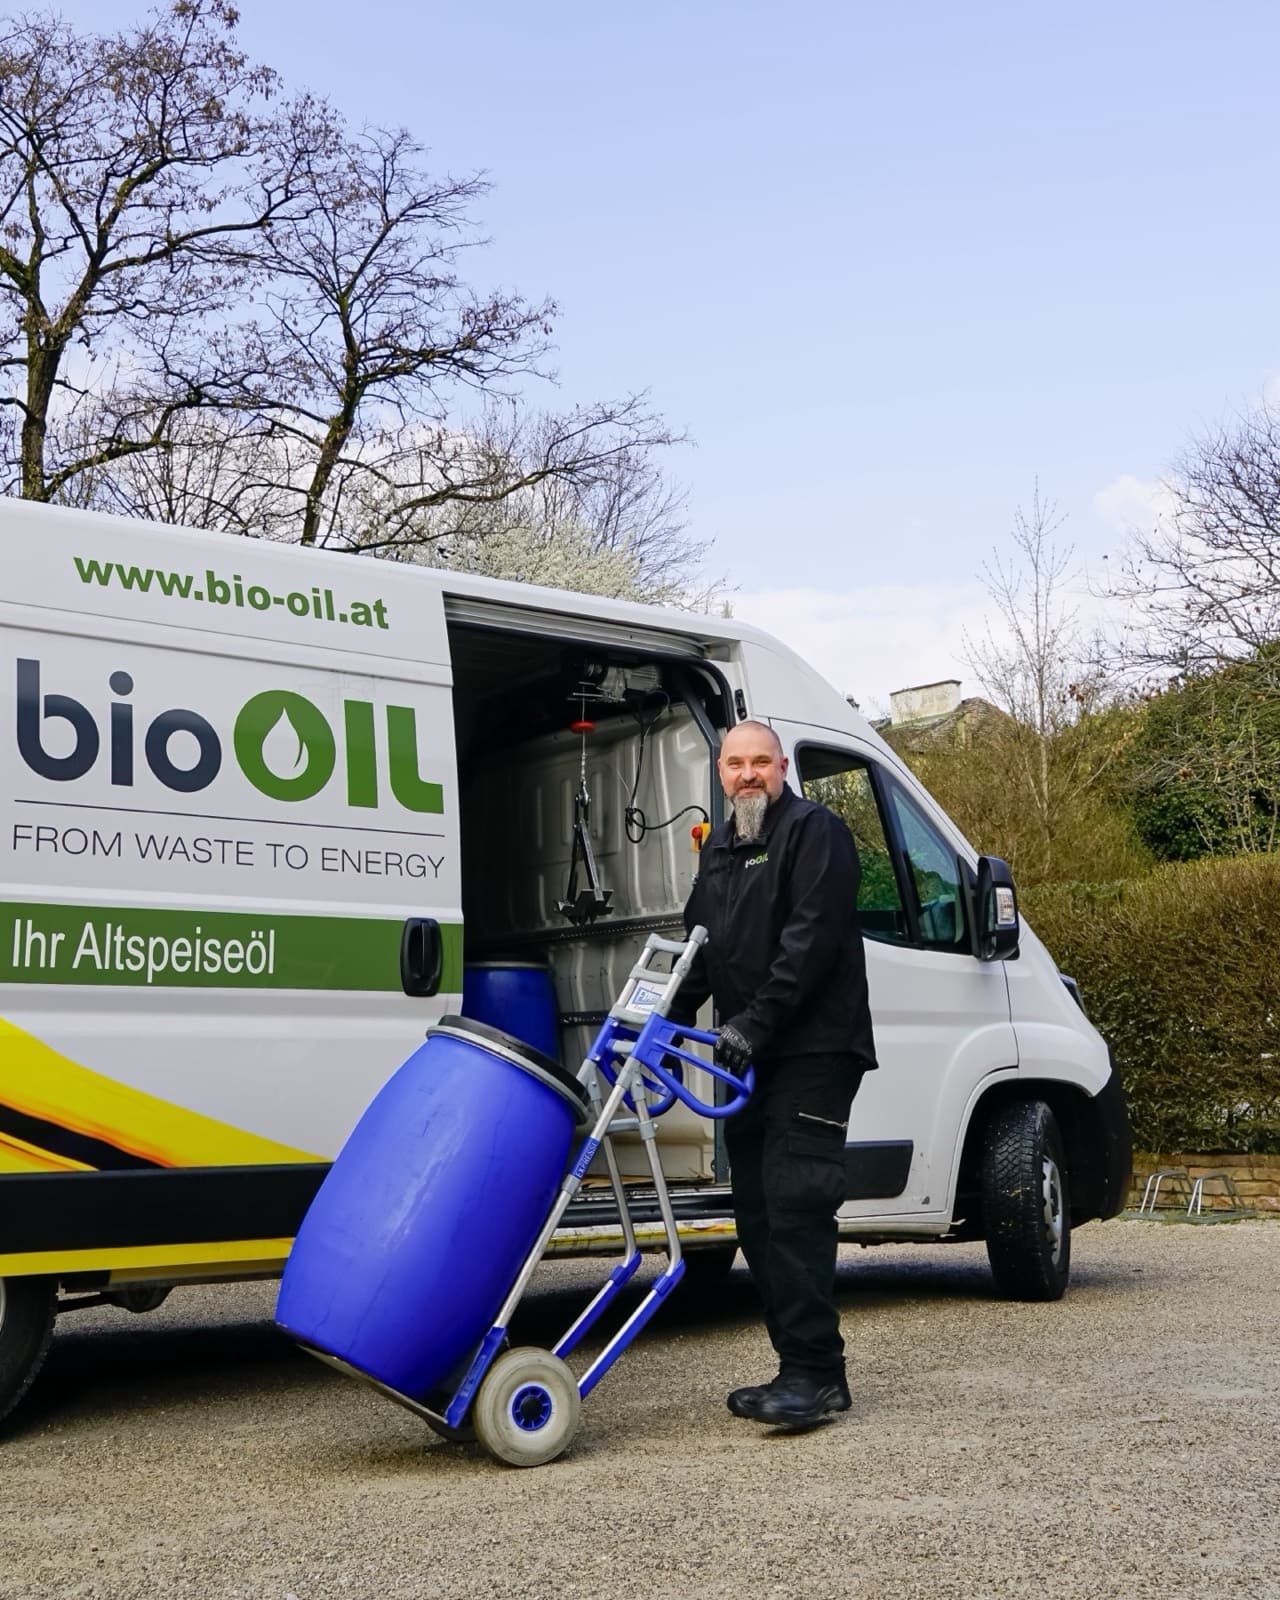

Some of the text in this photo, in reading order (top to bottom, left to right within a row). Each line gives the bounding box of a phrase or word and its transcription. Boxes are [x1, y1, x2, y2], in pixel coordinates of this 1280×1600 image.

[73, 557, 389, 630] www.bio-oil.at
[13, 824, 445, 879] FROM WASTE TO ENERGY
[12, 918, 276, 983] Ihr Altspeiseöl
